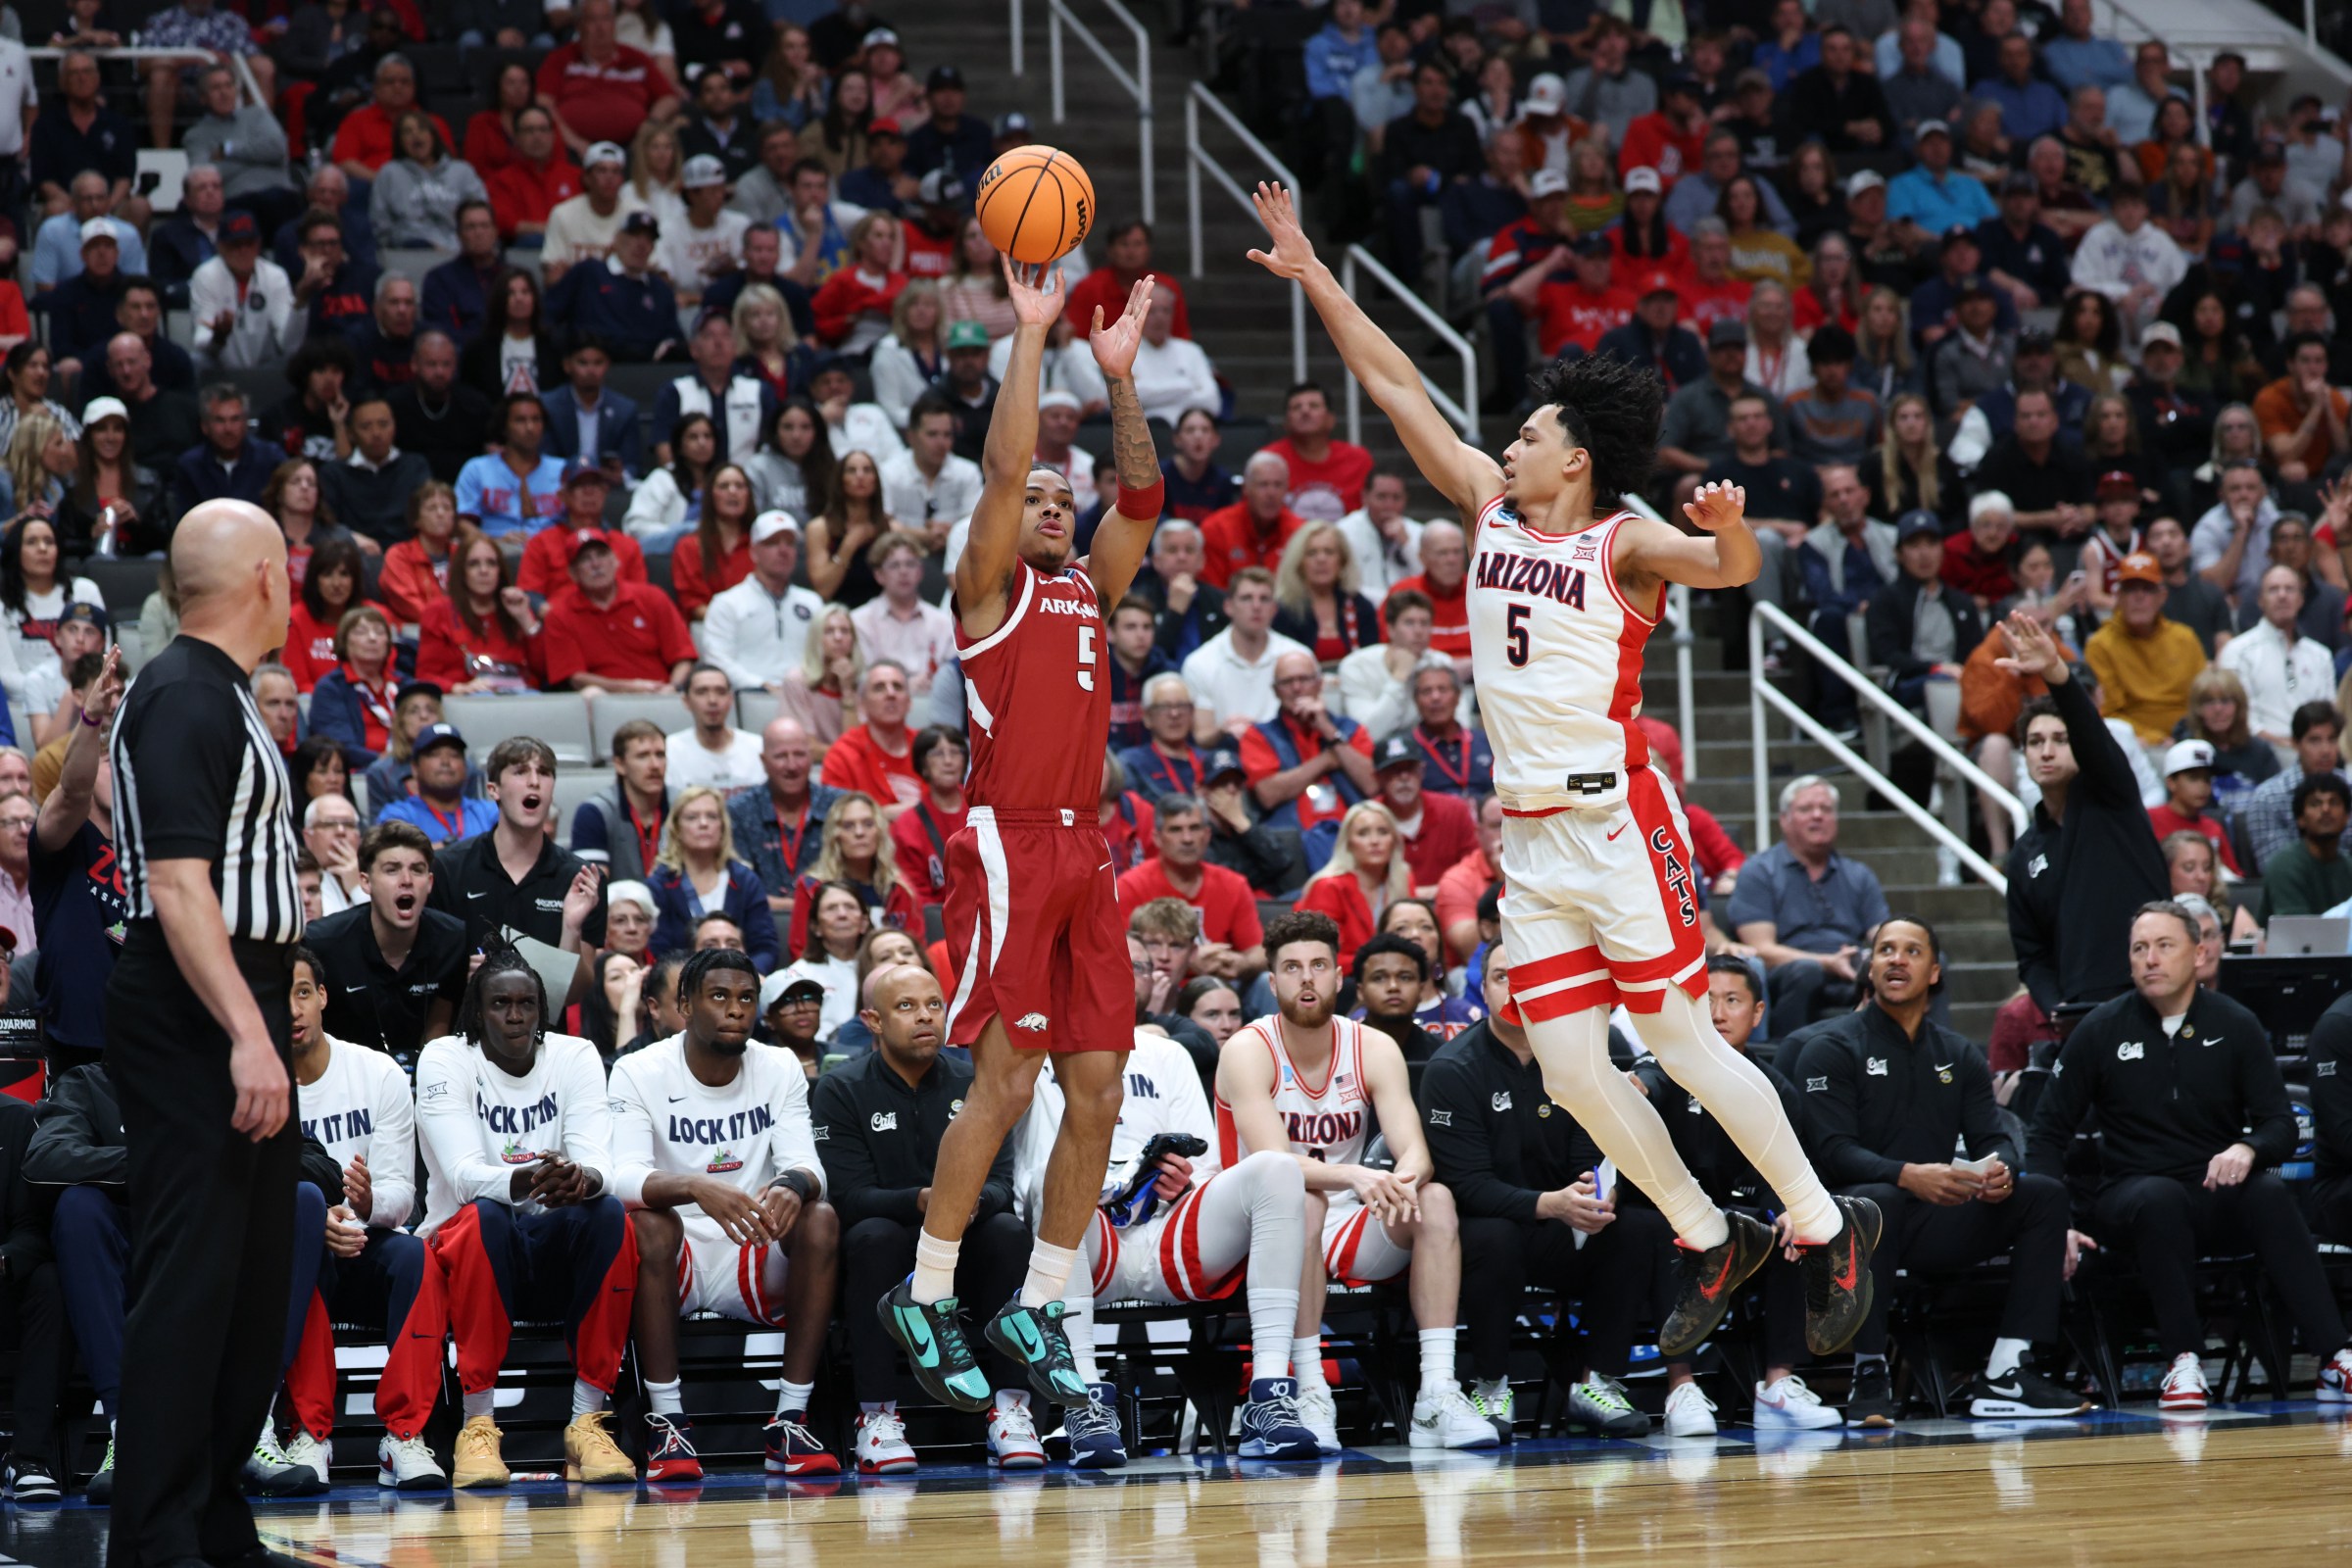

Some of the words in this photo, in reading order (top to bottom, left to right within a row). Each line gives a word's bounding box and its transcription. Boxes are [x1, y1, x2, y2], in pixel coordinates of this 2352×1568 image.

[1476, 552, 1586, 612] ARIZONA
[1506, 603, 1531, 667] 5
[1077, 624, 1097, 692] 5
[1650, 825, 1696, 927] CATS
[1129, 1073, 1159, 1099] IN.
[322, 1114, 341, 1144] IT
[521, 1104, 541, 1133] IT
[668, 1113, 727, 1145] LOCK
[728, 1111, 746, 1141] IT
[747, 1102, 775, 1136] IN.
[871, 1112, 897, 1132] Cats
